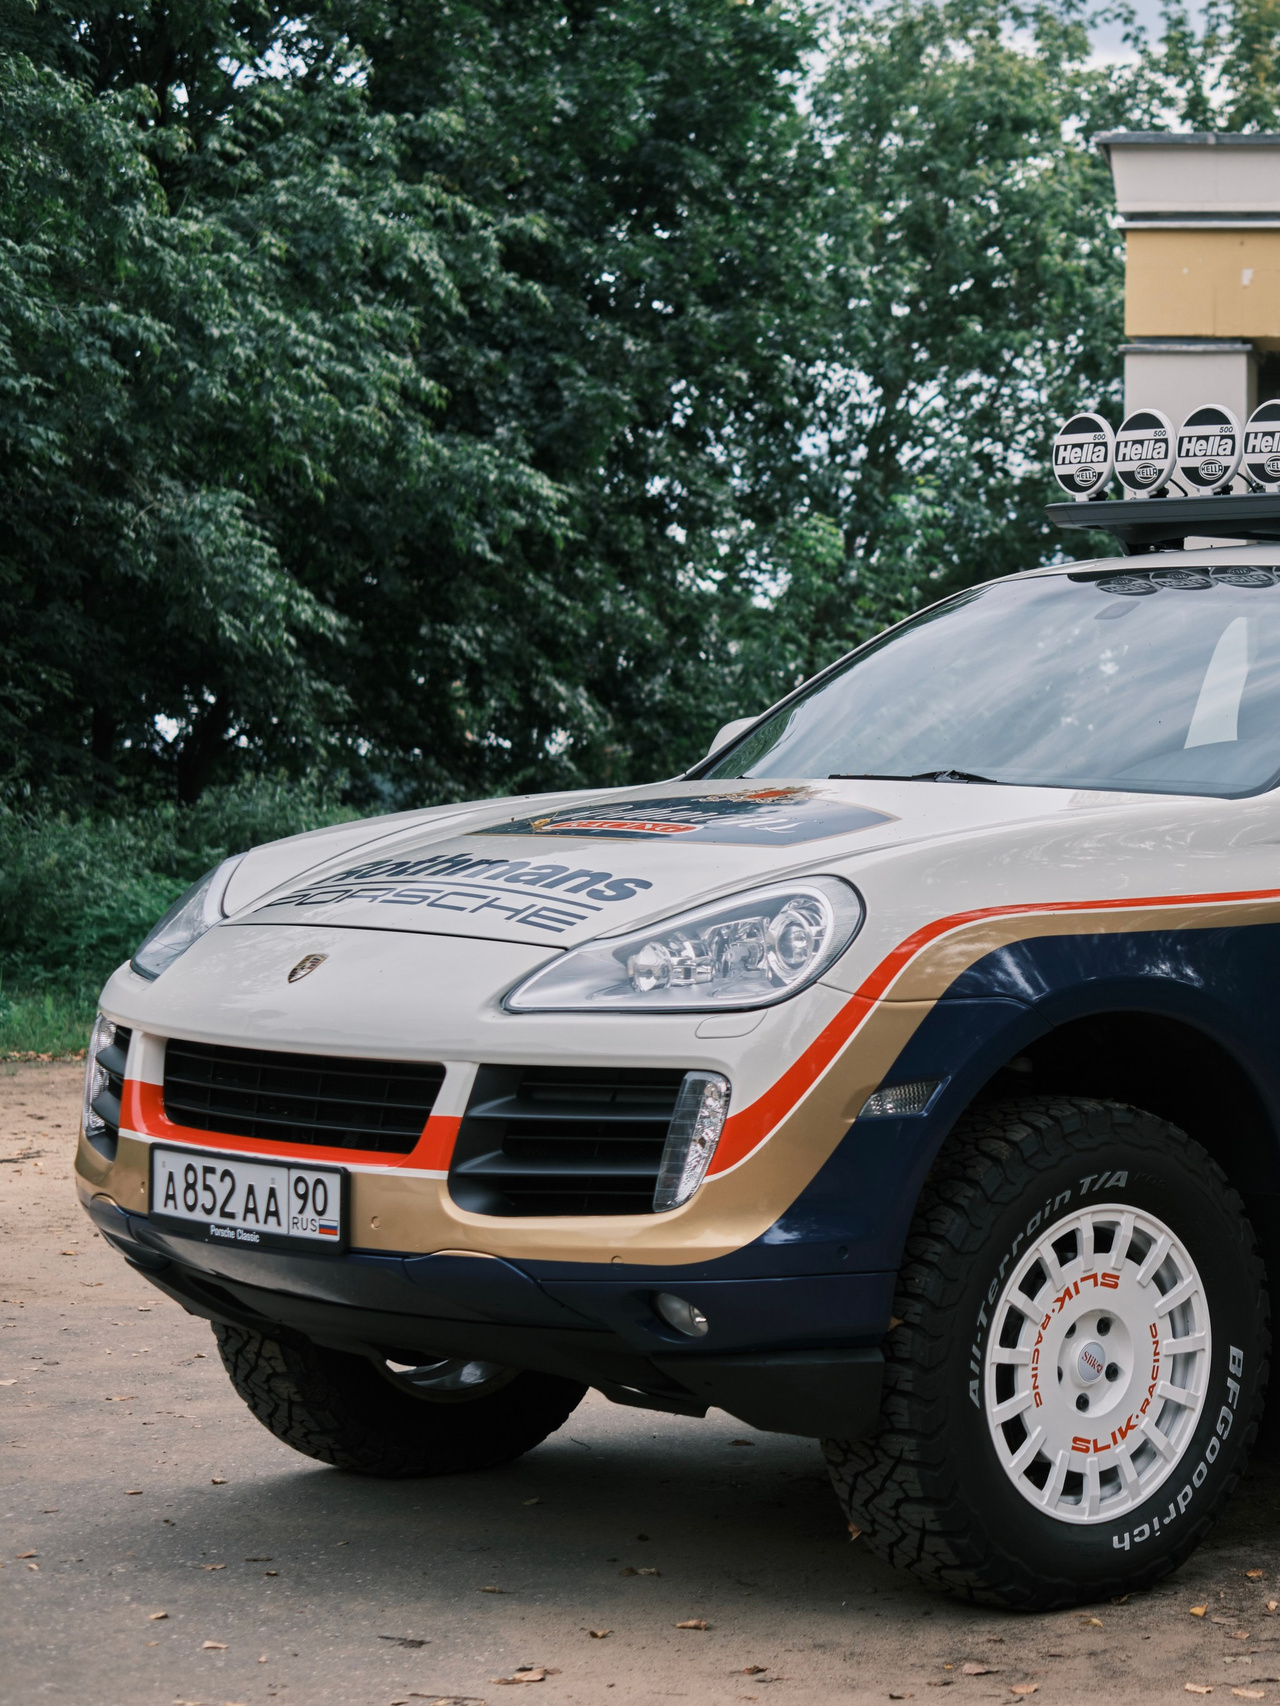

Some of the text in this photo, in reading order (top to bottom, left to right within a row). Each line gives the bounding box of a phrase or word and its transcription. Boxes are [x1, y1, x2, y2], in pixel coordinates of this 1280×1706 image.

[1057, 443, 1105, 464] Hella
[1117, 440, 1166, 461] Hella
[1180, 436, 1233, 457] Hella
[1077, 470, 1098, 480] HELLA
[1137, 468, 1158, 477] HELLA
[1201, 464, 1224, 473] HELLA
[311, 853, 653, 901] Rothmans
[252, 887, 588, 933] PORSCHE
[293, 1175, 328, 1217] 90
[209, 1224, 261, 1243] Porsche Classic
[291, 1216, 318, 1232] RUS
[968, 1170, 1129, 1409] All-Terrain T/A
[1033, 1272, 1121, 1408] SLIK RACING
[1070, 1322, 1160, 1454] SLIK RACING
[1112, 1344, 1244, 1551] BFGoodrich
